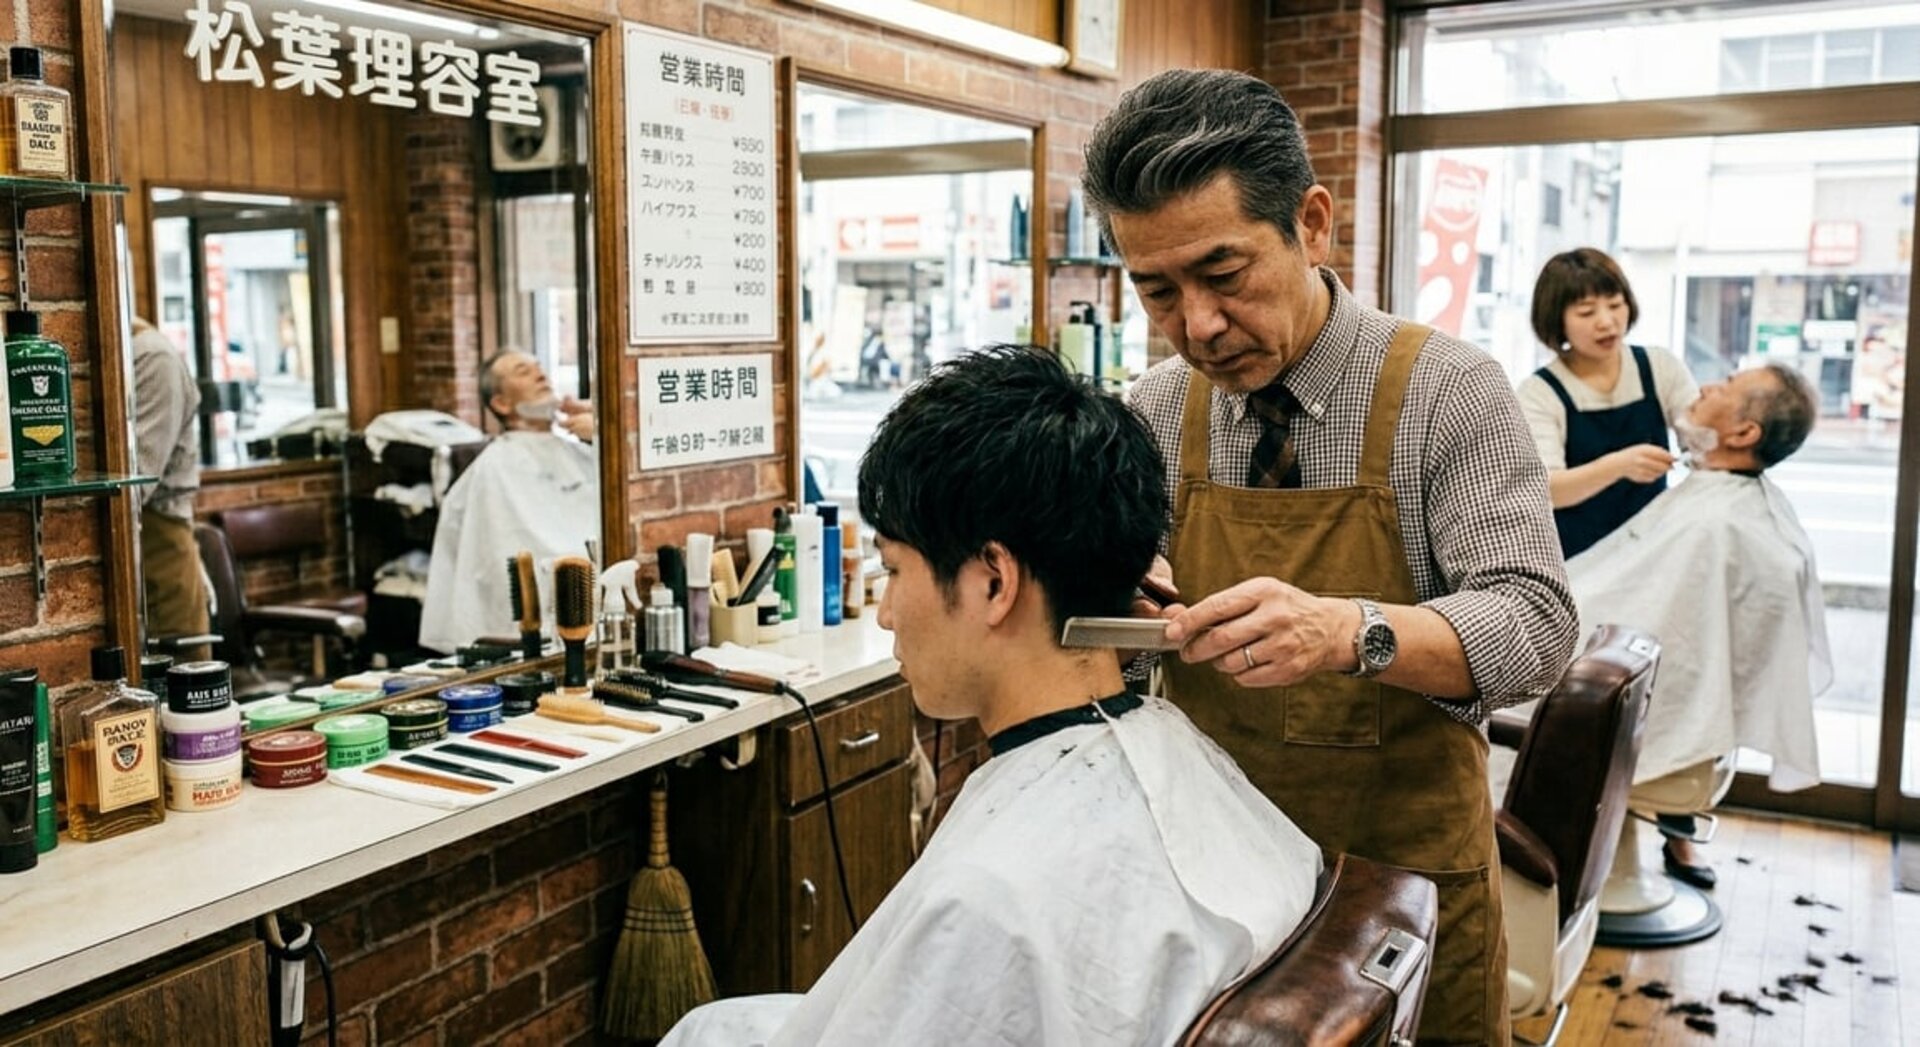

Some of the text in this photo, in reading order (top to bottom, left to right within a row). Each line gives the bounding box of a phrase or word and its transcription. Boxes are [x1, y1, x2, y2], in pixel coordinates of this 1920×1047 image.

[184, 0, 542, 127] 松葉理容室
[660, 51, 745, 97] 営業時間
[657, 366, 758, 404] 営業時間
